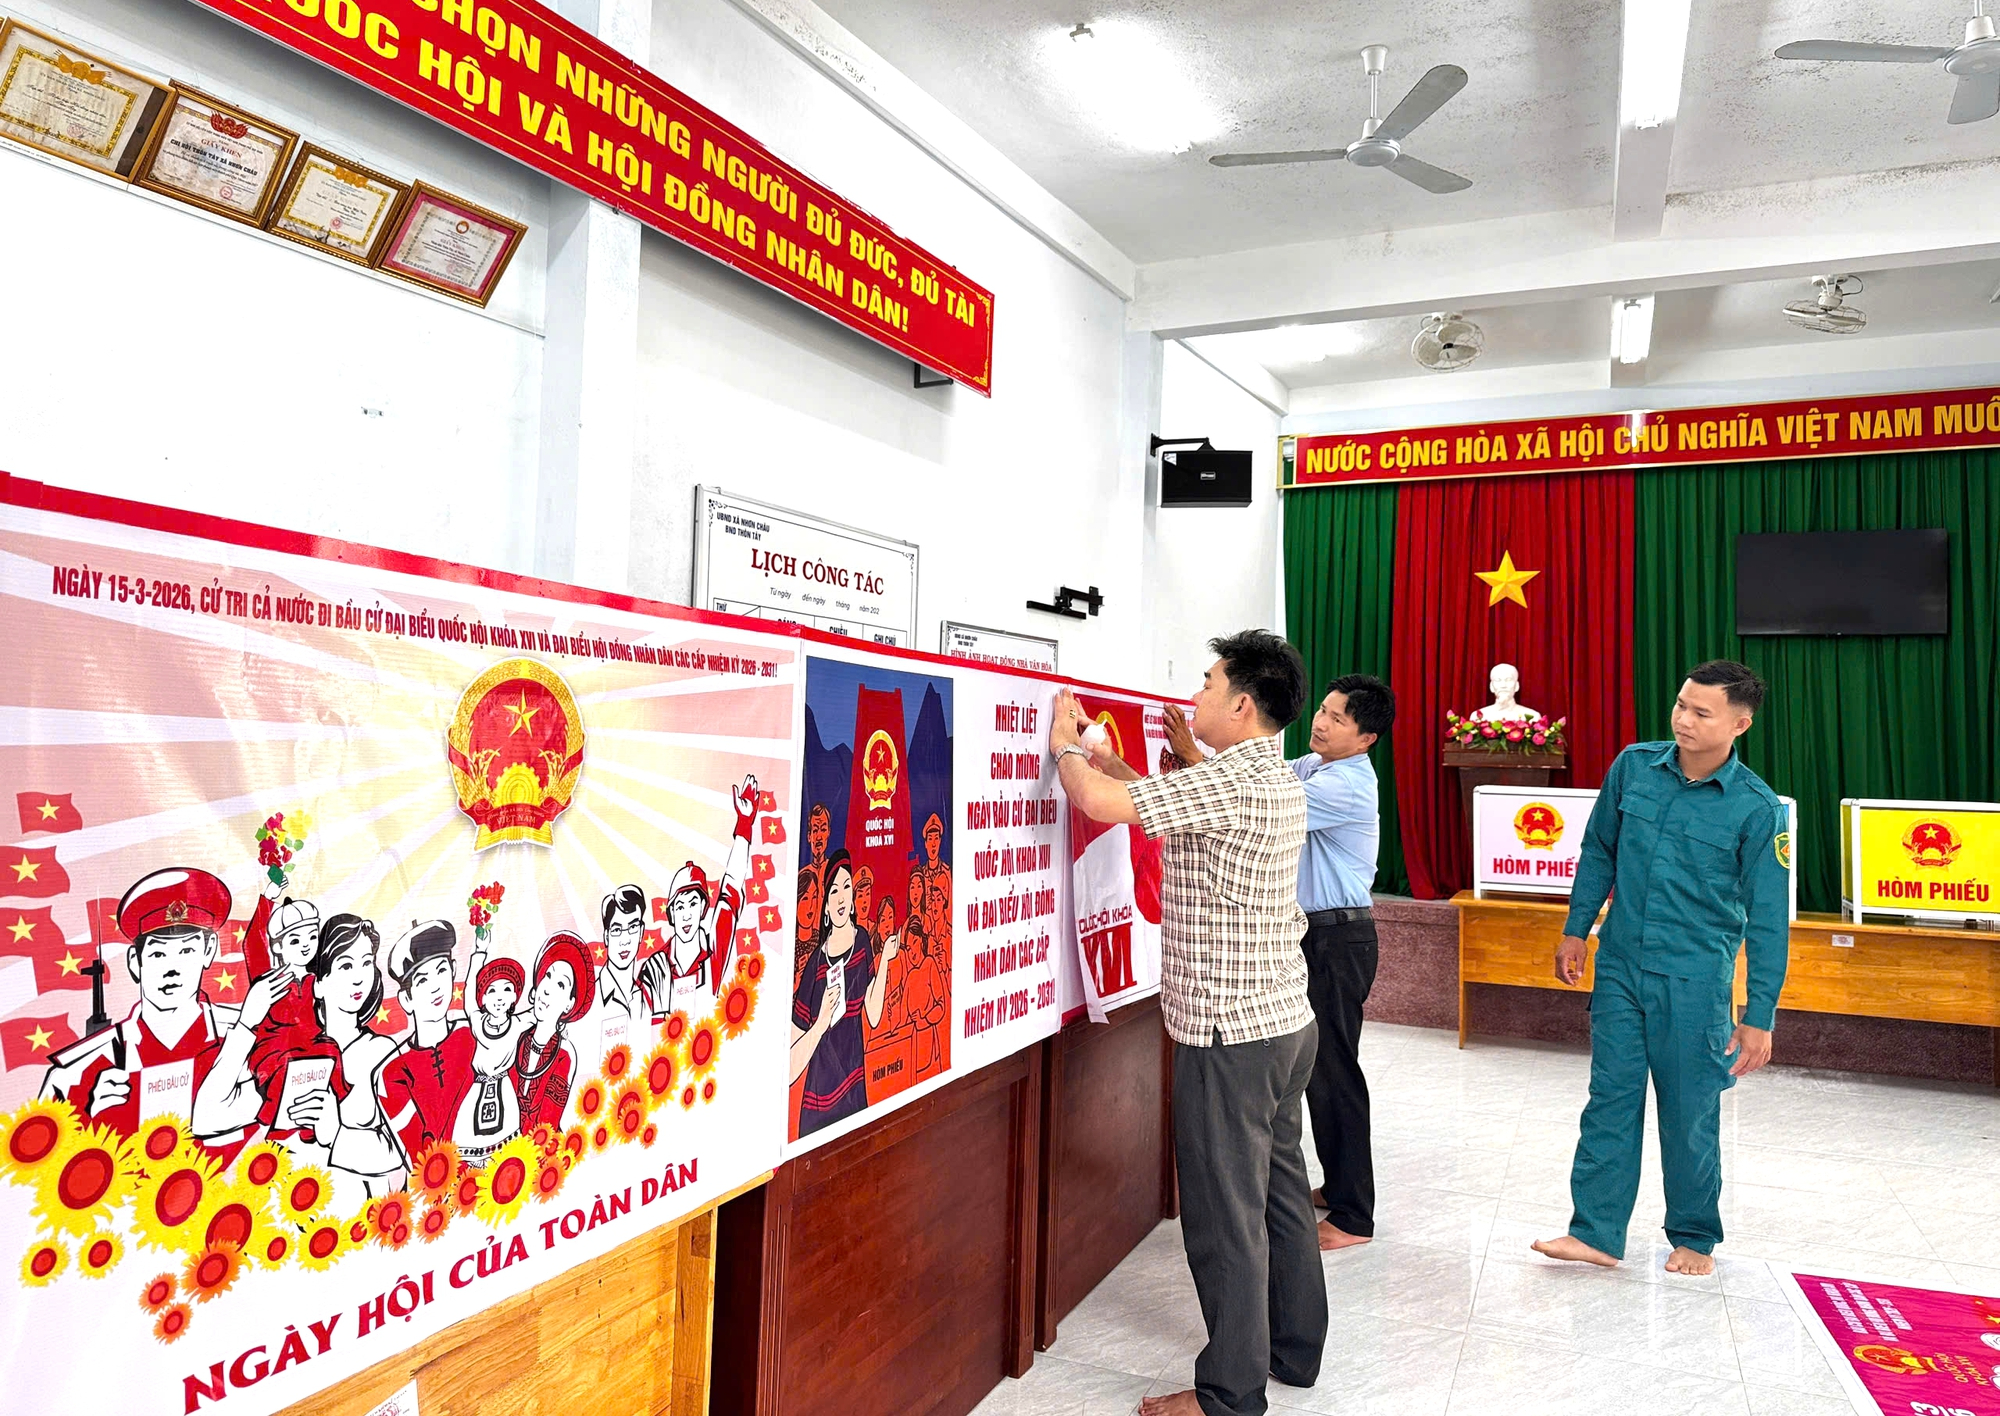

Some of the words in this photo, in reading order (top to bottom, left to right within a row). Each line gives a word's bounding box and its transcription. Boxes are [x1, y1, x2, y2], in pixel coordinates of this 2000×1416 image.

[410, 0, 541, 74] HỌN
[555, 50, 692, 160] NHỮNG
[702, 138, 798, 222] NGƯỜI
[806, 202, 842, 247] ĐỦ
[849, 229, 904, 289] ĐỨC,
[910, 267, 939, 305] ĐỦ
[945, 288, 975, 327] TÀI
[418, 38, 502, 117] HỘI
[518, 91, 573, 155] VÀ
[587, 130, 652, 196] HỘI
[663, 172, 757, 251] ĐỒNG
[766, 229, 844, 298] NHÂN
[852, 277, 909, 333] DÂN!
[1306, 440, 1372, 474] NƯỚC
[1379, 436, 1448, 473] CỘNG
[1455, 428, 1509, 464] HÒA
[1516, 426, 1551, 460] XÃ
[1560, 423, 1604, 462] HỘI
[1614, 414, 1669, 455] CHỦ
[1678, 411, 1769, 451] NGHĨA
[1777, 407, 1840, 449] VIỆT
[1849, 407, 1923, 441] NAM
[717, 512, 731, 522] UBND
[751, 548, 796, 578] LỊCH
[802, 557, 849, 588] CÔNG
[854, 570, 884, 595] TÁC
[53, 563, 103, 599] NGÀY
[108, 574, 196, 614] 15-3-2026,
[200, 577, 223, 614] CỬ
[225, 589, 248, 617] TRI
[252, 585, 271, 620] CẢ
[276, 593, 314, 625] NƯỚC
[318, 602, 331, 627] ĐI
[335, 598, 361, 631] BẦU
[365, 600, 384, 633] CỬ
[385, 611, 405, 640] ĐẠI
[409, 608, 435, 639] BIỂU
[438, 613, 467, 643] QUỐC
[470, 620, 488, 649] HỘI
[490, 624, 518, 649] KHÓA
[519, 629, 536, 651] XVI
[537, 629, 551, 652] VÀ
[552, 634, 569, 658] ĐẠI
[570, 630, 591, 657] BIỂU
[592, 636, 608, 663] HỘI
[608, 637, 633, 661] ĐỒNG
[633, 643, 657, 665] NHÂN
[657, 645, 674, 667] DÂN
[674, 647, 690, 669] CÁC
[691, 648, 706, 670] CẤP
[707, 652, 730, 676] NHIỆM
[731, 655, 740, 674] KỲ
[741, 659, 756, 676] 2026
[995, 700, 1020, 739] NHIỆT
[1021, 702, 1038, 740] LIỆT
[990, 746, 1013, 780] CHÀO
[1015, 748, 1040, 780] MỪNG
[866, 815, 882, 832] QUỐC
[884, 816, 894, 831] HỘI
[967, 795, 991, 830] NGÀY
[992, 790, 1010, 828] BẦU
[1012, 792, 1024, 827] CỬ
[1025, 800, 1038, 831] ĐẠI
[1040, 788, 1057, 825] BIỂU
[884, 834, 894, 846] XVI
[974, 839, 999, 882] QUỐC
[1016, 840, 1036, 874] KHOÁ
[1493, 854, 1530, 876] HÒM
[967, 896, 979, 933] VÀ
[982, 899, 997, 934] ĐẠI
[999, 884, 1019, 925] BIỂU
[1035, 880, 1055, 917] ĐỒNG
[1877, 876, 1923, 899] HÒM
[1930, 878, 1989, 902] PHIẾU
[974, 944, 997, 983] NHÂN
[999, 939, 1017, 975] DÂN
[1019, 934, 1034, 969] CÁC
[964, 997, 994, 1039] NHIỆM
[997, 990, 1008, 1026] KỲ
[1009, 988, 1029, 1021] 2026
[872, 1067, 886, 1082] HÒM
[887, 1058, 904, 1075] PHIẾU
[182, 1312, 344, 1416] NGÀY
[356, 1273, 436, 1339] HỘI
[449, 1235, 531, 1289] CỦA
[538, 1194, 632, 1251] TOÀN
[641, 1157, 700, 1206] DÂN
